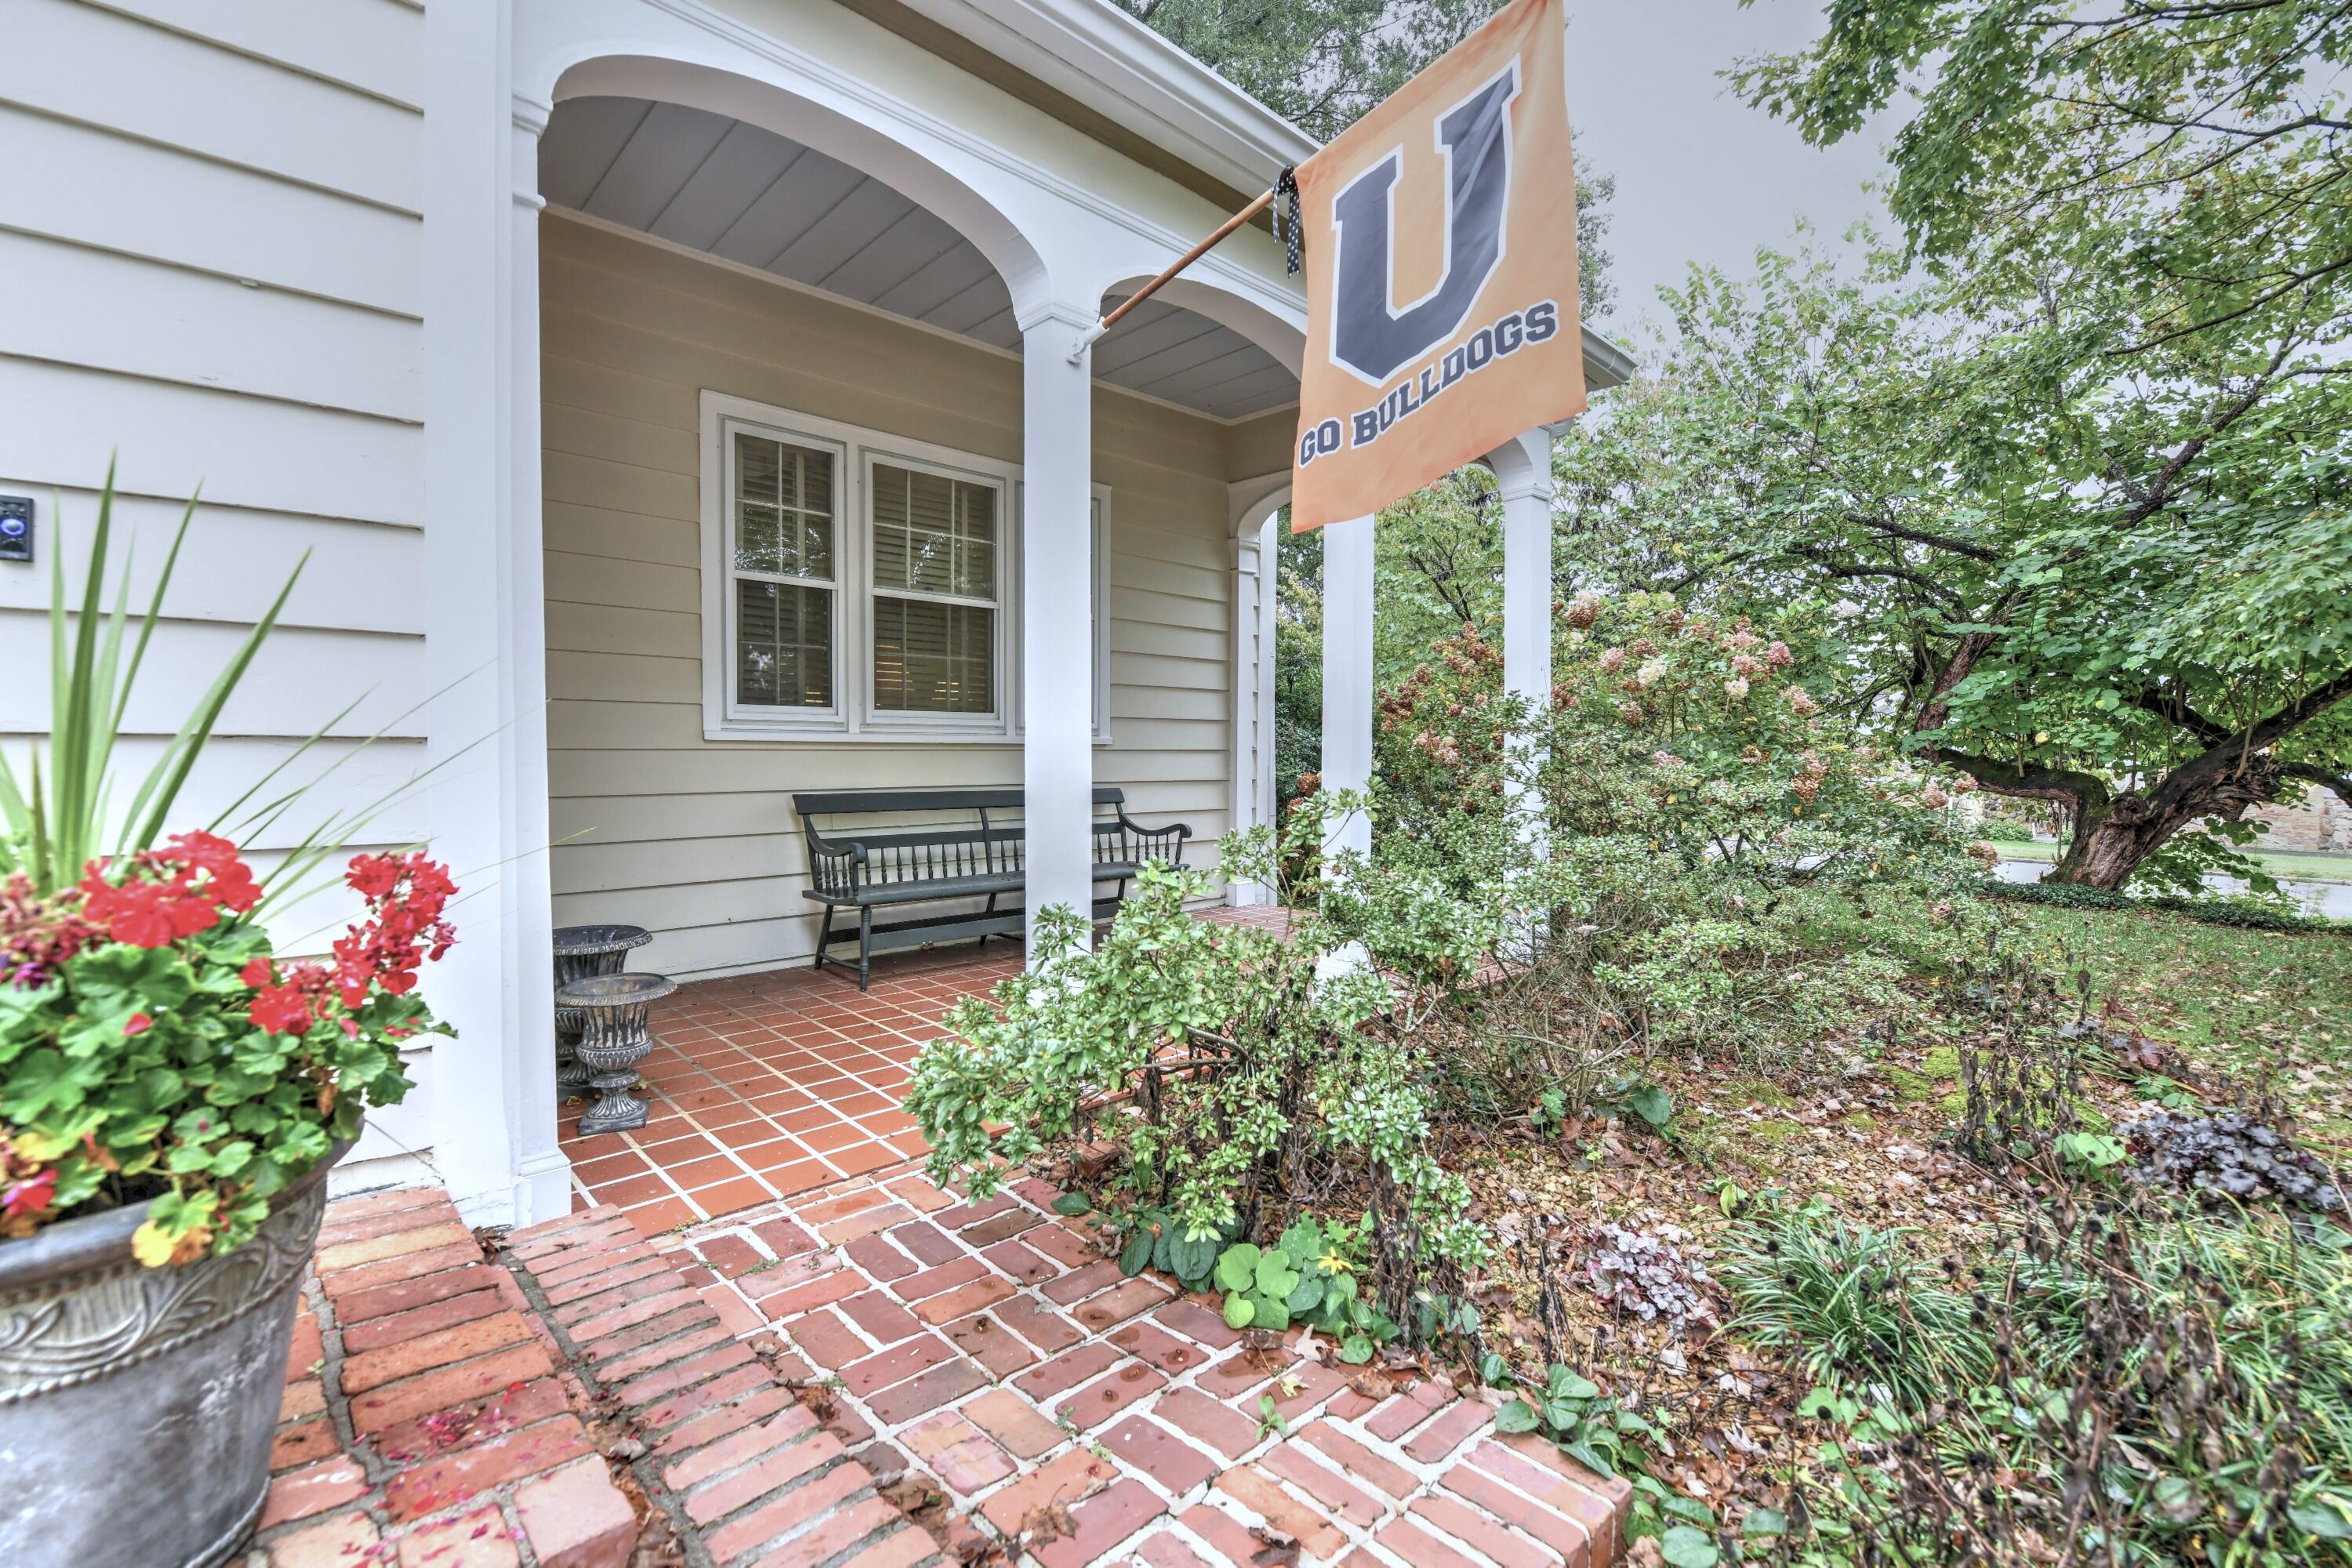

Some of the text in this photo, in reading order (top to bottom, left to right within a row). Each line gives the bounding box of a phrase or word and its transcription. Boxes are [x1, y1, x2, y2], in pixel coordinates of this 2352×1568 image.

[1330, 54, 1521, 387] U
[1299, 299, 1559, 466] GO BULLDOGS
